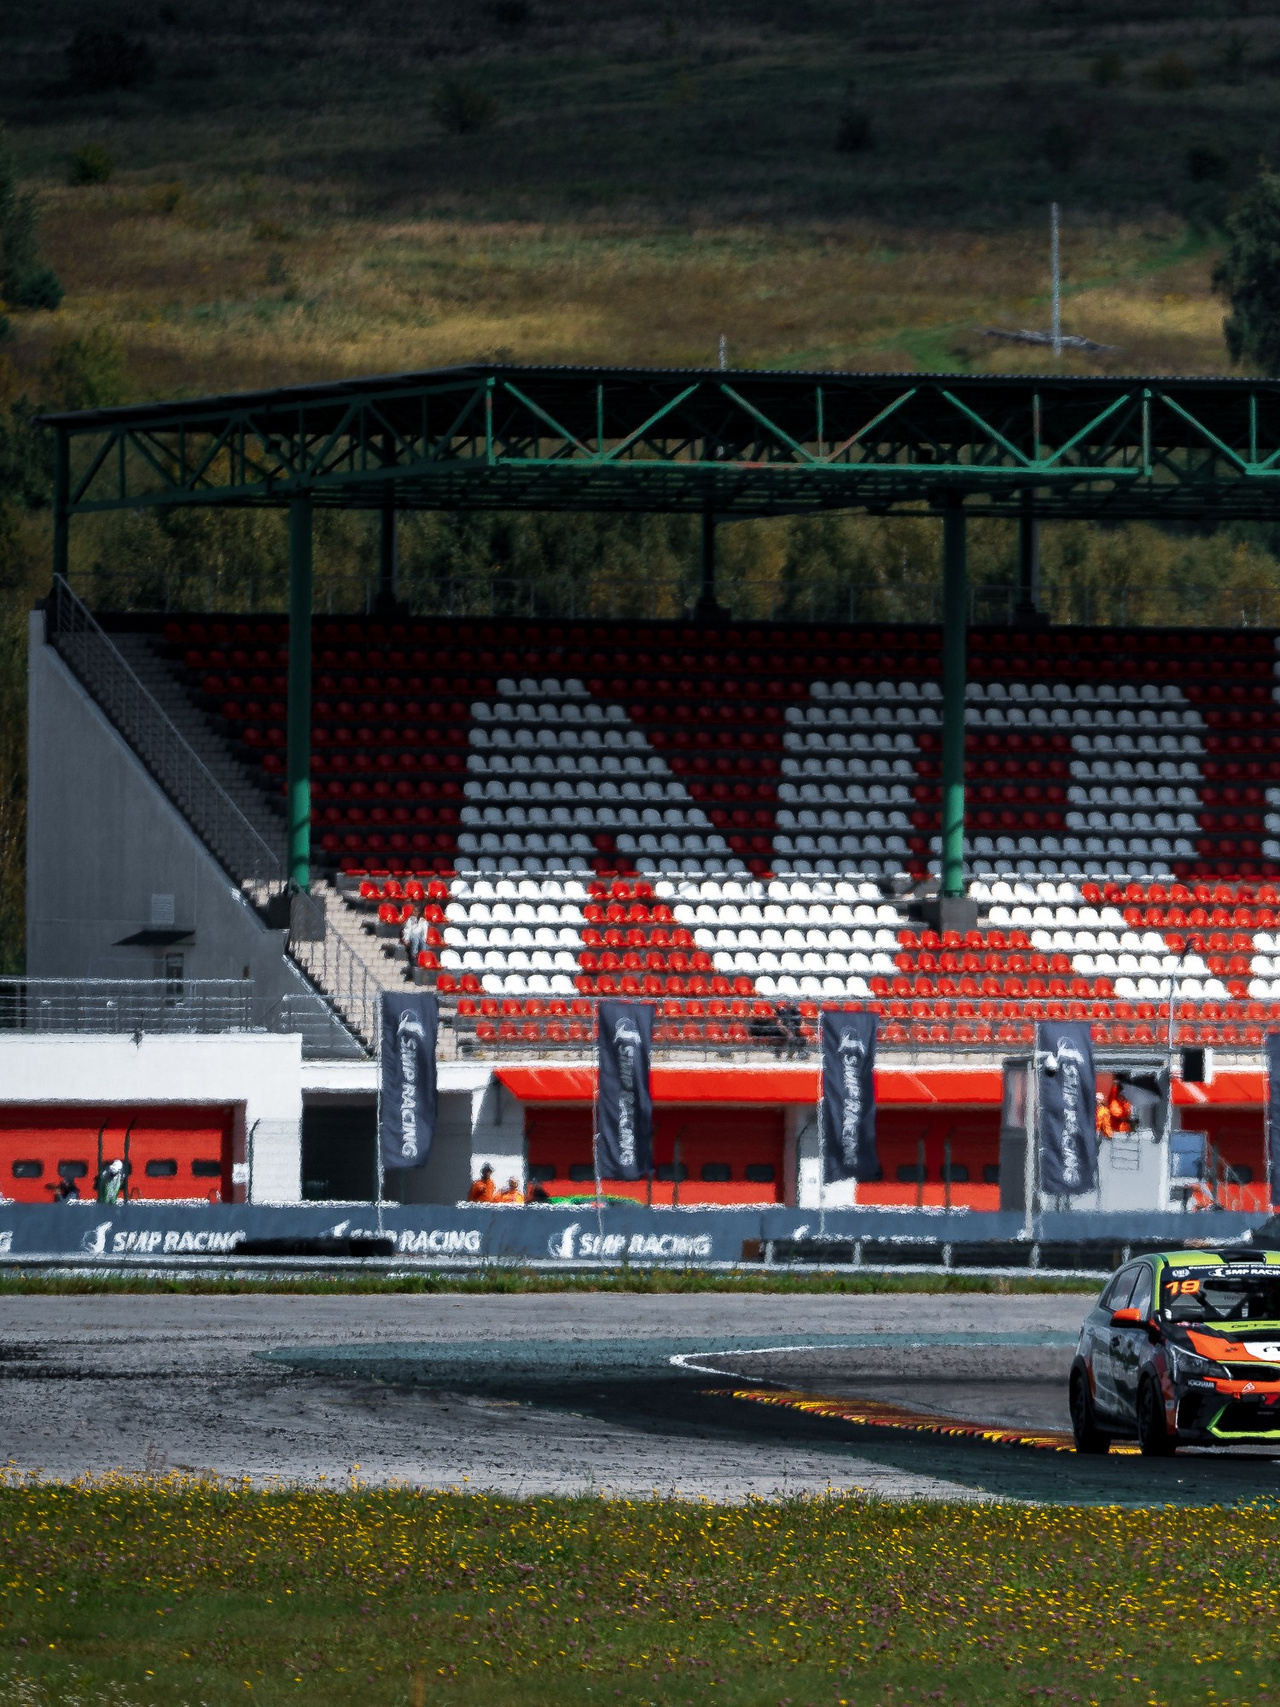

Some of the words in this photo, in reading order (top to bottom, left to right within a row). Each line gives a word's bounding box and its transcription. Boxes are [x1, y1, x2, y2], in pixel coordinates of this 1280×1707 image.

[399, 1035, 418, 1082] SMP
[843, 1054, 862, 1099] SMP
[399, 1082, 419, 1159] RACING
[113, 1230, 162, 1253] SMP
[399, 1229, 482, 1253] RACING
[579, 1233, 626, 1256] SMP
[628, 1233, 712, 1257] RACING
[1225, 1268, 1250, 1277] SMP
[1165, 1279, 1202, 1296] 19
